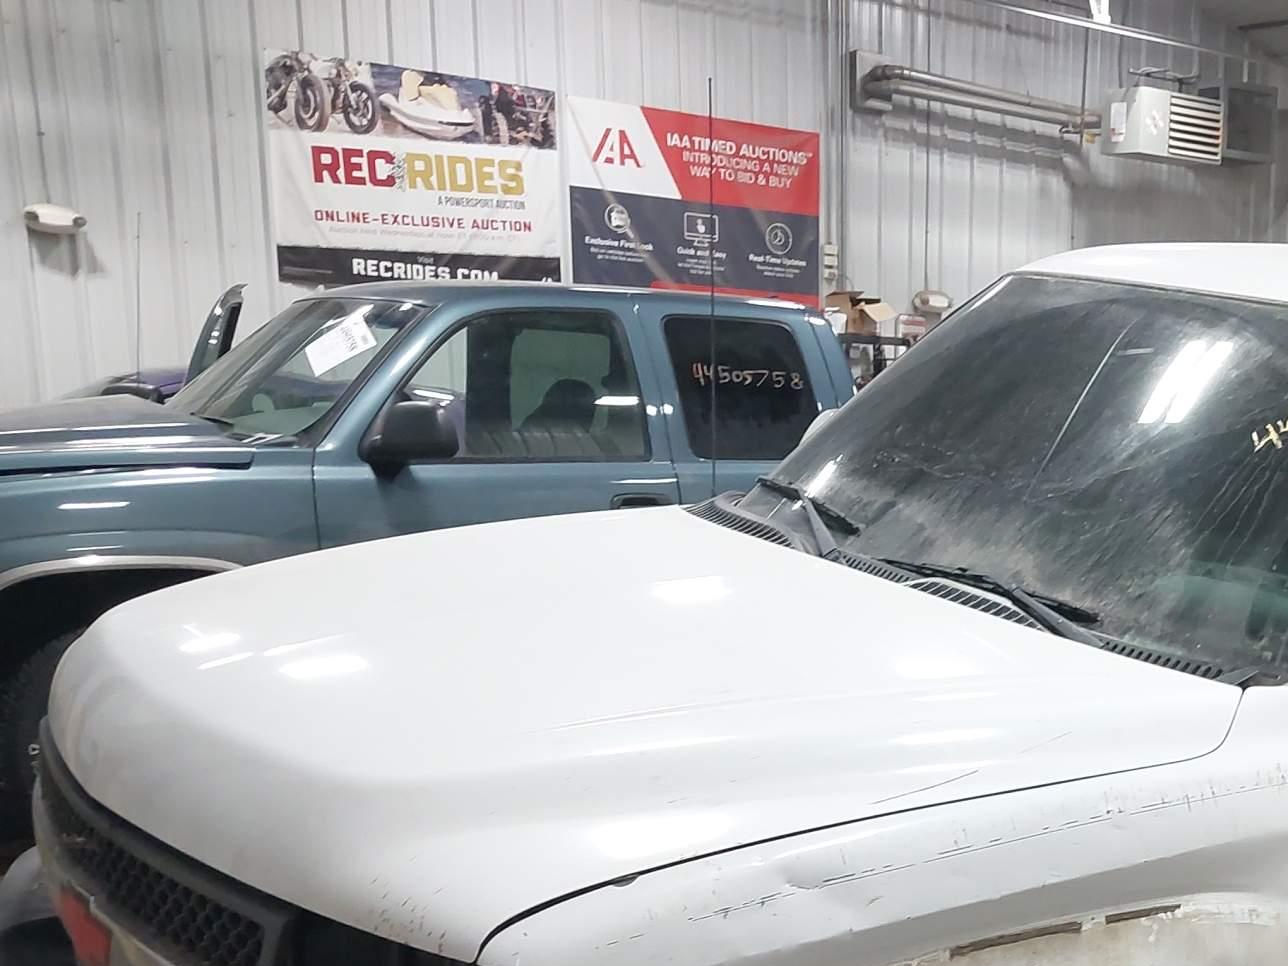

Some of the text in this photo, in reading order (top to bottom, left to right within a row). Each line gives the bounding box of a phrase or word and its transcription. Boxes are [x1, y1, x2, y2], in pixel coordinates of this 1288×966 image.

[666, 132, 691, 149] IAA
[691, 136, 737, 155] TIMED
[311, 145, 526, 196] REC RIDES
[718, 168, 735, 181] TO
[736, 170, 755, 184] BID
[768, 175, 793, 189] BUY
[773, 162, 800, 177] NEW
[314, 209, 465, 230] ONLINE-EXCLUSIVE
[471, 218, 532, 233] AUCTION
[352, 257, 499, 281] RECRIDESCOM
[692, 362, 804, 390] 44505758
